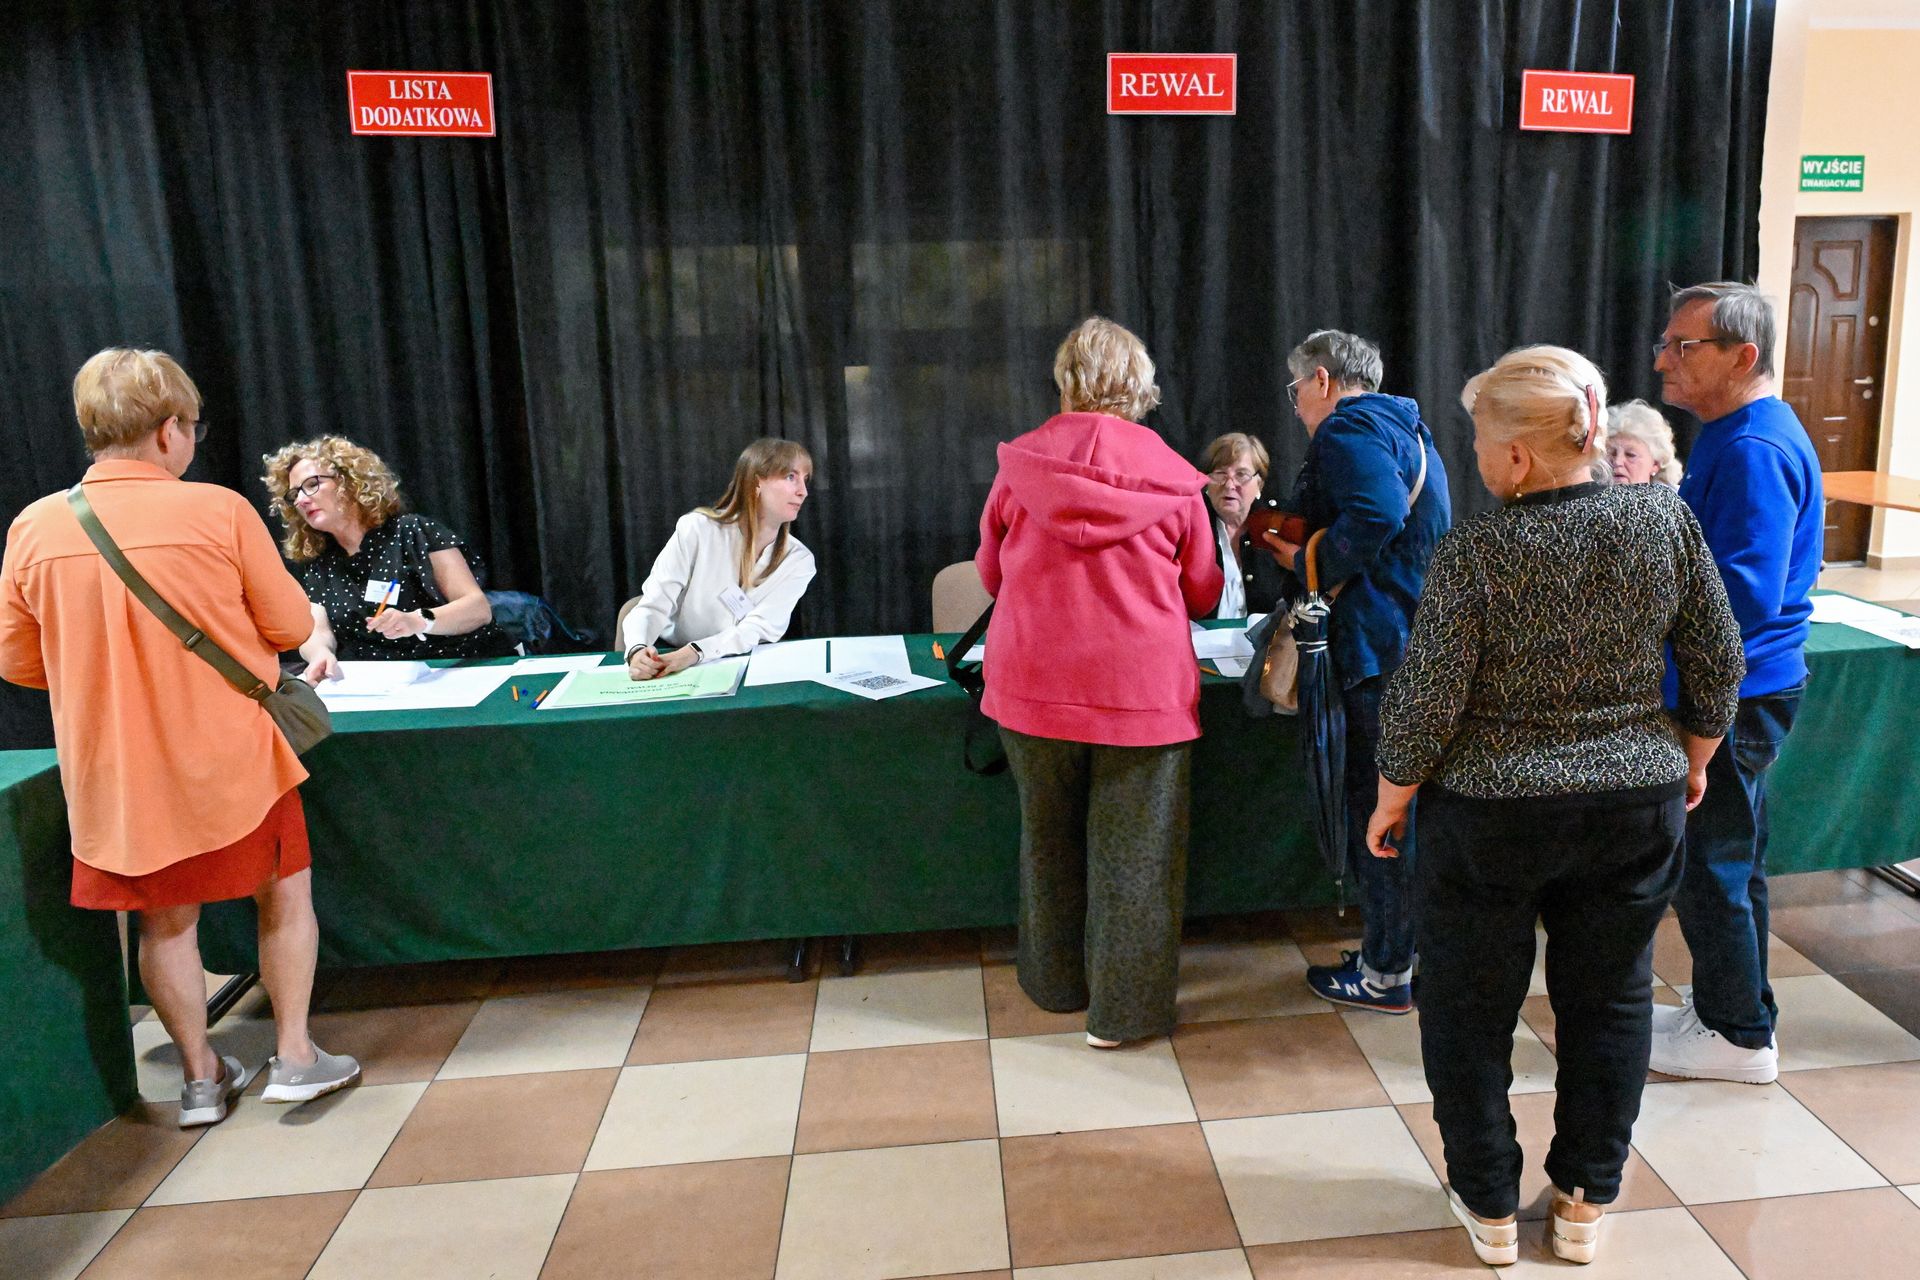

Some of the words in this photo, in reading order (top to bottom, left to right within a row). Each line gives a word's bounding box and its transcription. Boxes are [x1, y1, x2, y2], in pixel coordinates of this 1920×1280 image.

[388, 79, 453, 100] LISTA
[1120, 72, 1225, 97] REWAL
[1540, 87, 1613, 115] REWAL
[360, 106, 484, 127] DODATKOWA
[1803, 158, 1862, 174] WYJŚCIE
